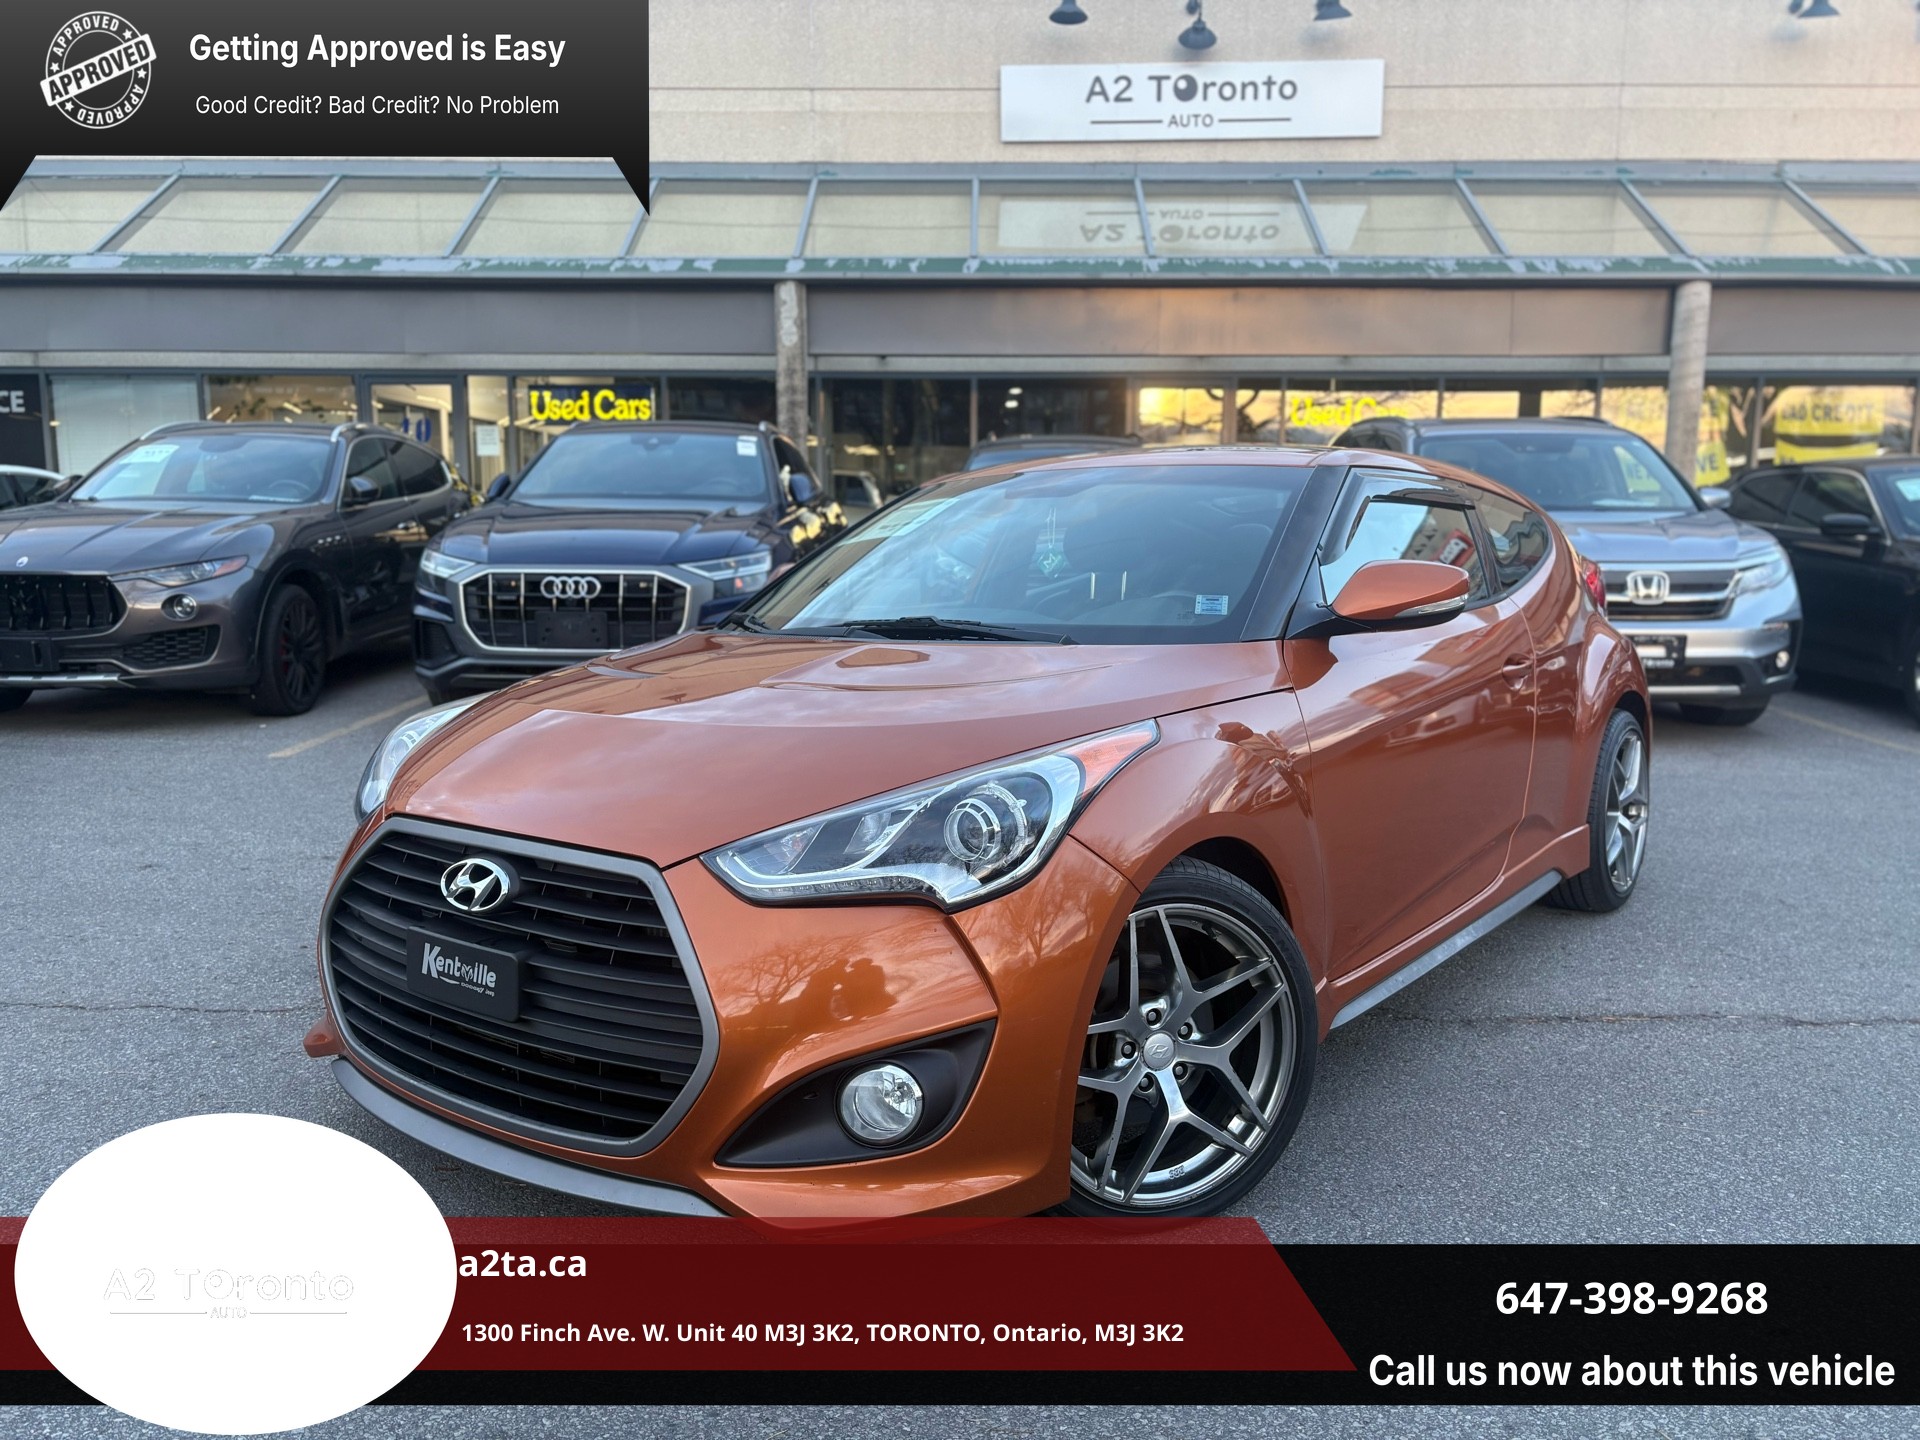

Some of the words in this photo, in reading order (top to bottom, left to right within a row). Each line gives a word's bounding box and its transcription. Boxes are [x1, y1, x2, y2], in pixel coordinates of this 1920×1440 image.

[1085, 75, 1133, 103] A2
[1167, 114, 1214, 128] AUTO
[529, 390, 590, 420] Used
[593, 389, 651, 421] Cars
[1289, 397, 1352, 426] Used
